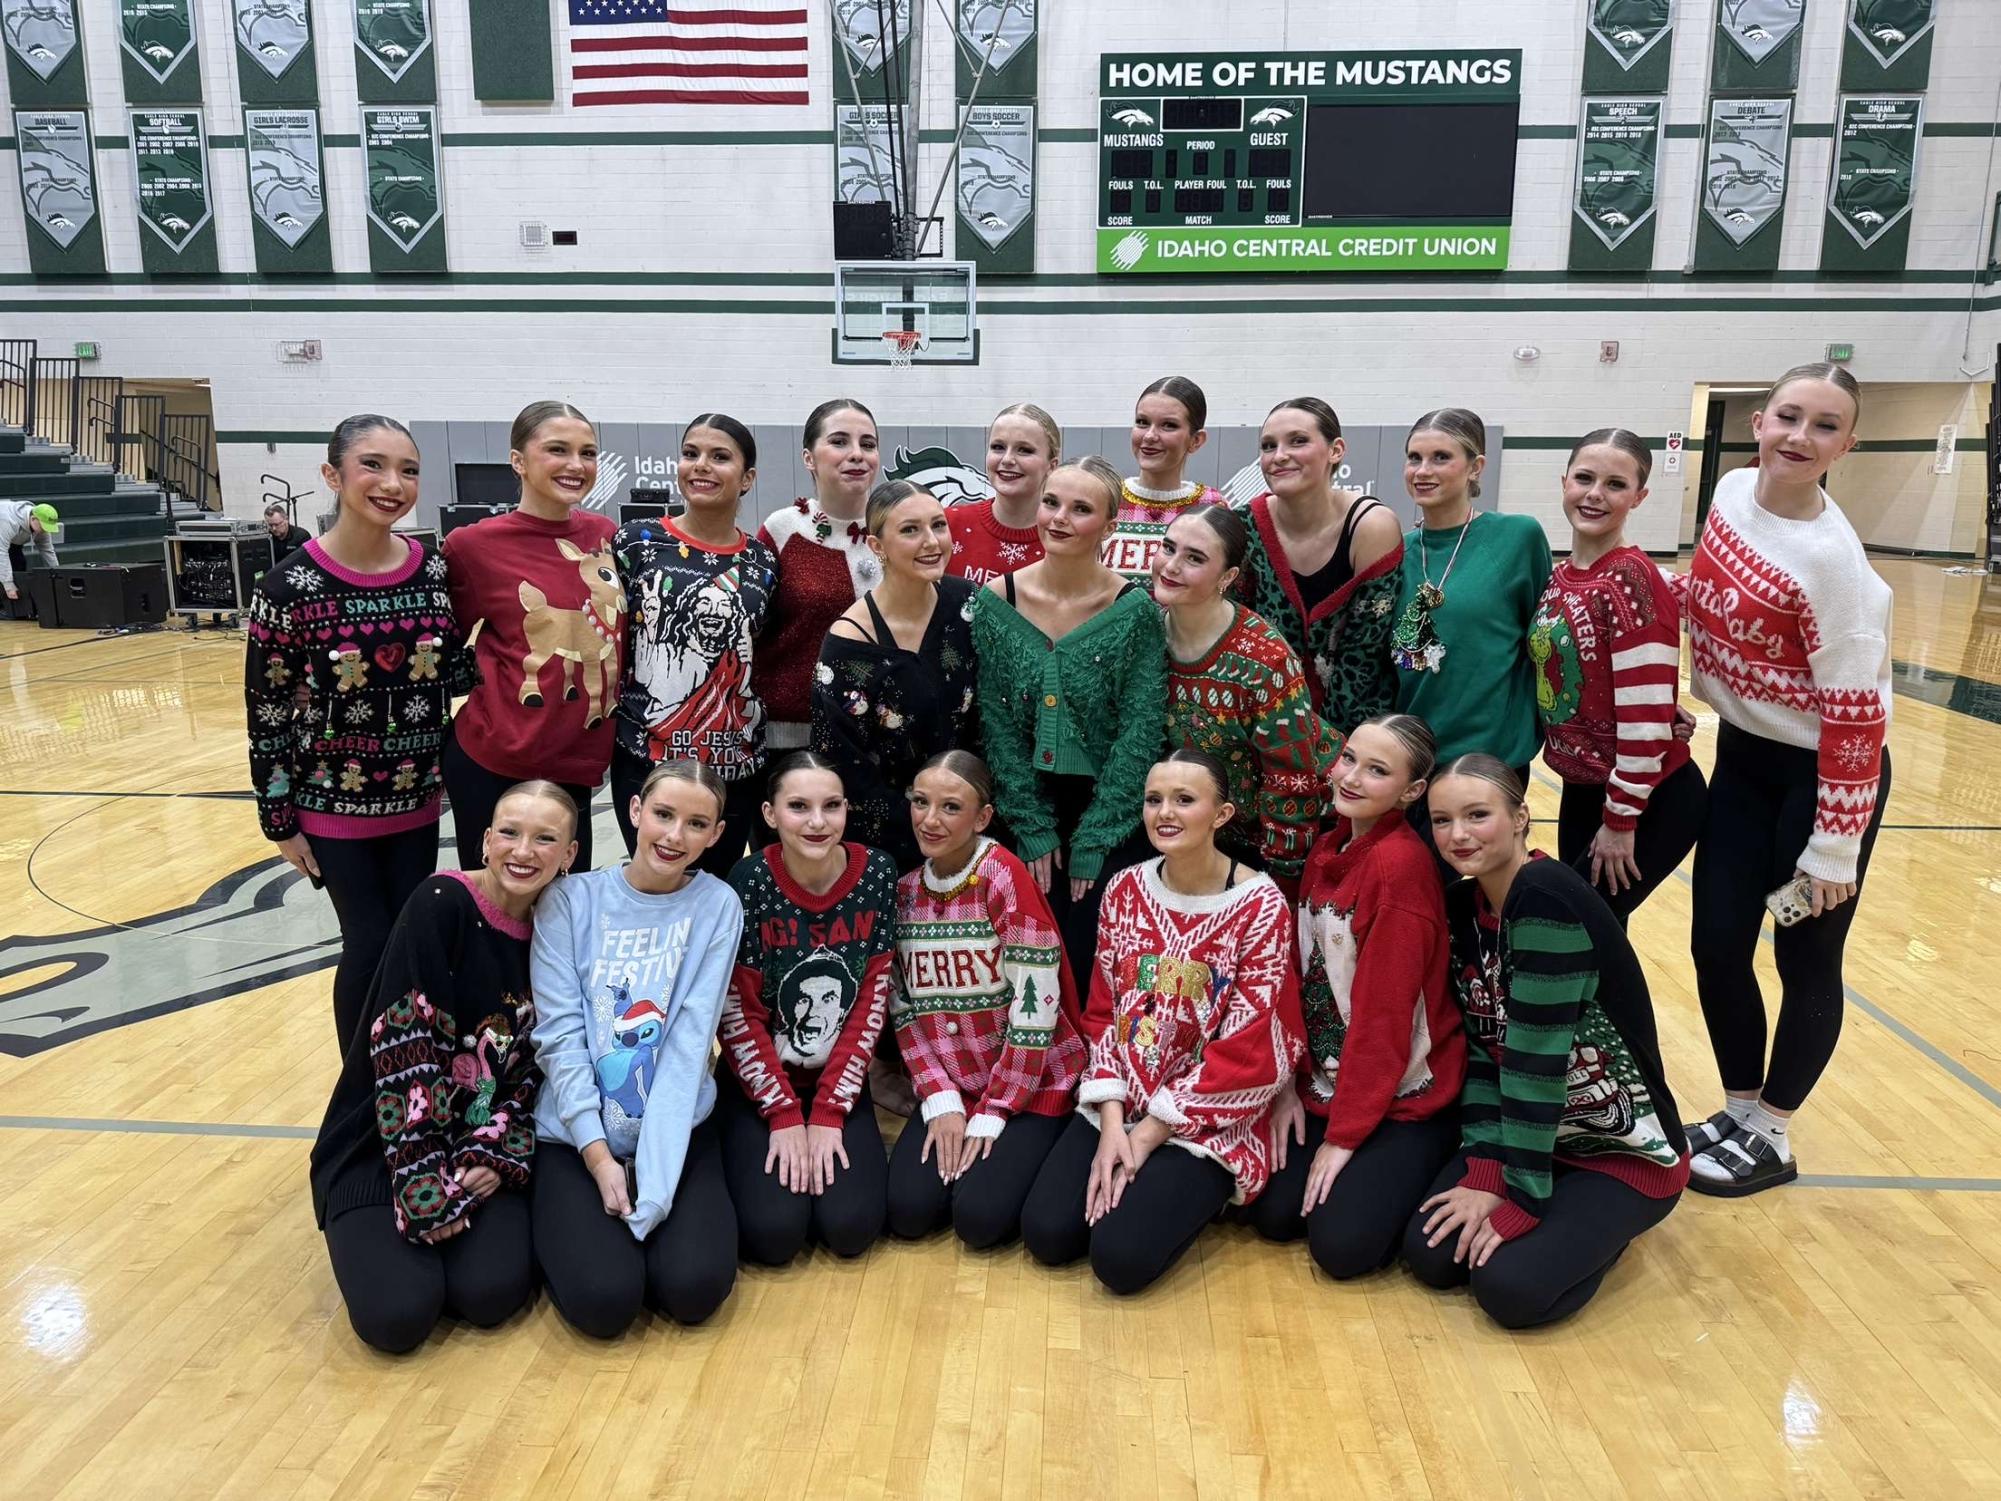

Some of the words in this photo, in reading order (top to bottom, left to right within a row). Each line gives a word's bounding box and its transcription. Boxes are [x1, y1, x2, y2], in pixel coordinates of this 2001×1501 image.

[1109, 63, 1203, 88] HOME
[1212, 62, 1256, 87] OF
[1264, 61, 1326, 86] THE
[1336, 59, 1512, 86] MUSTANGS
[972, 112, 991, 120] BOYS
[992, 112, 1020, 120] SOCCER
[1609, 107, 1637, 115] SPEECH
[149, 118, 182, 126] SOFTBALL
[254, 116, 274, 124] GIRLS
[275, 116, 309, 124] LACROSSE
[1104, 133, 1164, 147] MUSTANGS
[1186, 141, 1216, 150] PERIOD
[1250, 132, 1288, 146] GUEST
[1108, 181, 1134, 190] FOULS
[1144, 181, 1164, 190] T.O.L.
[1175, 180, 1204, 189] PLAYER
[1206, 180, 1227, 189] FOUL
[1236, 180, 1256, 189] T.O.L.
[1266, 179, 1292, 189] FOULS
[1107, 216, 1133, 225] SCORE
[1185, 215, 1212, 225] MATCH
[1264, 215, 1291, 224] SCORE
[1157, 239, 1227, 258] IDAHO
[1233, 239, 1332, 257] CENTRAL
[1338, 238, 1418, 256] CREDIT
[1424, 238, 1496, 256] UNION
[635, 456, 678, 474] Idah
[635, 476, 681, 494] Cent
[1098, 539, 1162, 569] MER
[1690, 576, 1723, 618] nta
[291, 601, 338, 623] RKLE
[345, 592, 427, 614] SPARKLE
[1540, 587, 1561, 602] OUR
[1563, 591, 1597, 662] SWEATERS
[314, 735, 381, 752] CHEER
[383, 731, 441, 751] CHEER
[672, 730, 692, 746] GO
[333, 797, 418, 815] SPARKLE
[809, 911, 876, 947] SAN
[601, 917, 692, 958] FEELIN
[590, 947, 686, 989] FESTIV
[900, 944, 1004, 988] MERRY
